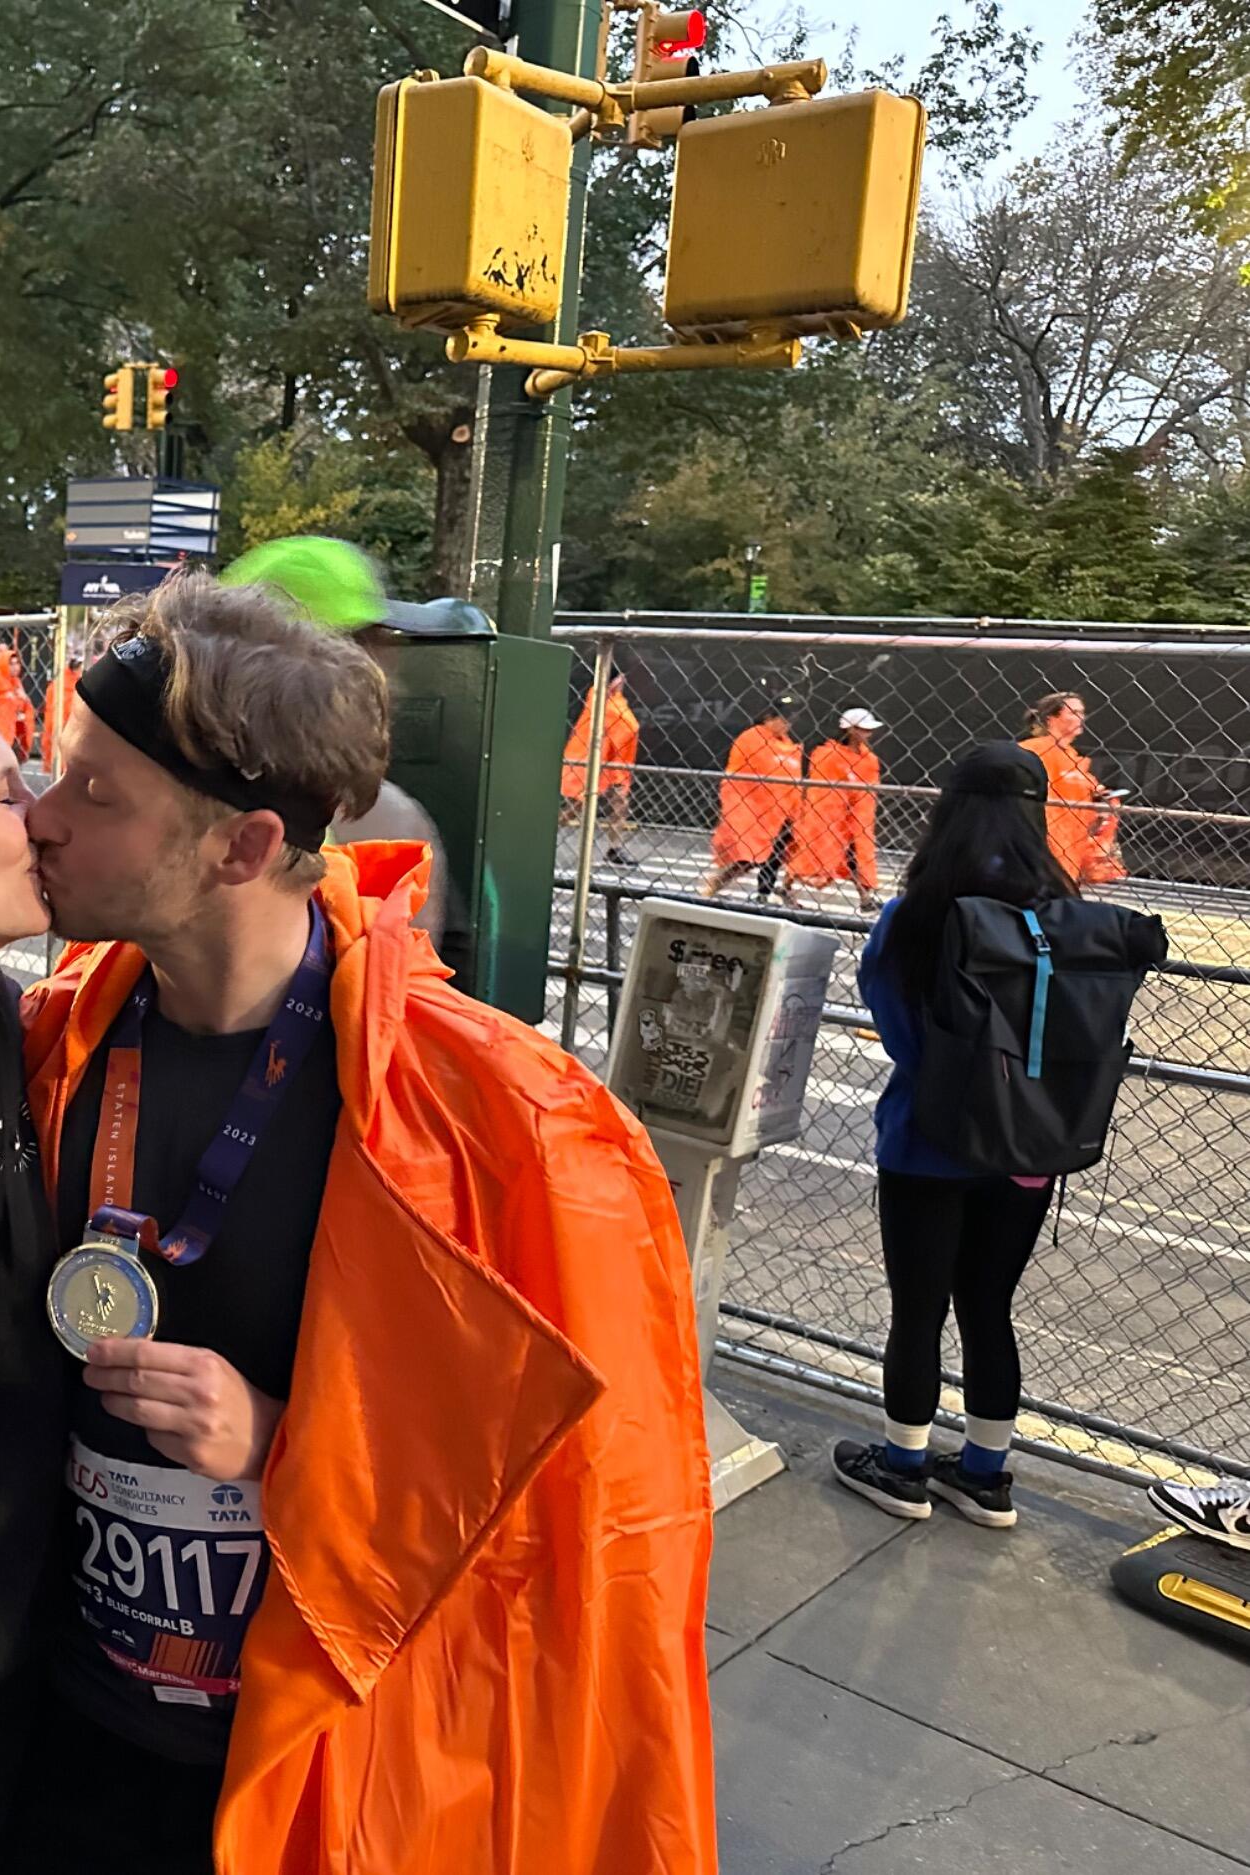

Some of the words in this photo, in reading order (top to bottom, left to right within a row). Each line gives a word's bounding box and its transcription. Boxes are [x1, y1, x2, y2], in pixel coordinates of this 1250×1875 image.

[286, 998, 323, 1022] 2023
[110, 1083, 126, 1139] STATEN
[222, 1124, 257, 1146] 2023
[104, 1147, 118, 1206] ISLAND
[108, 1471, 138, 1487] TATA
[111, 1482, 186, 1505] CONSULTANCY
[112, 1494, 159, 1516] SERVICES
[208, 1510, 251, 1522] TATA
[76, 1505, 262, 1617] 29117
[93, 1586, 104, 1604] 3
[107, 1597, 132, 1617] BLUE
[131, 1608, 180, 1632] CORRAL
[179, 1618, 196, 1636] B
